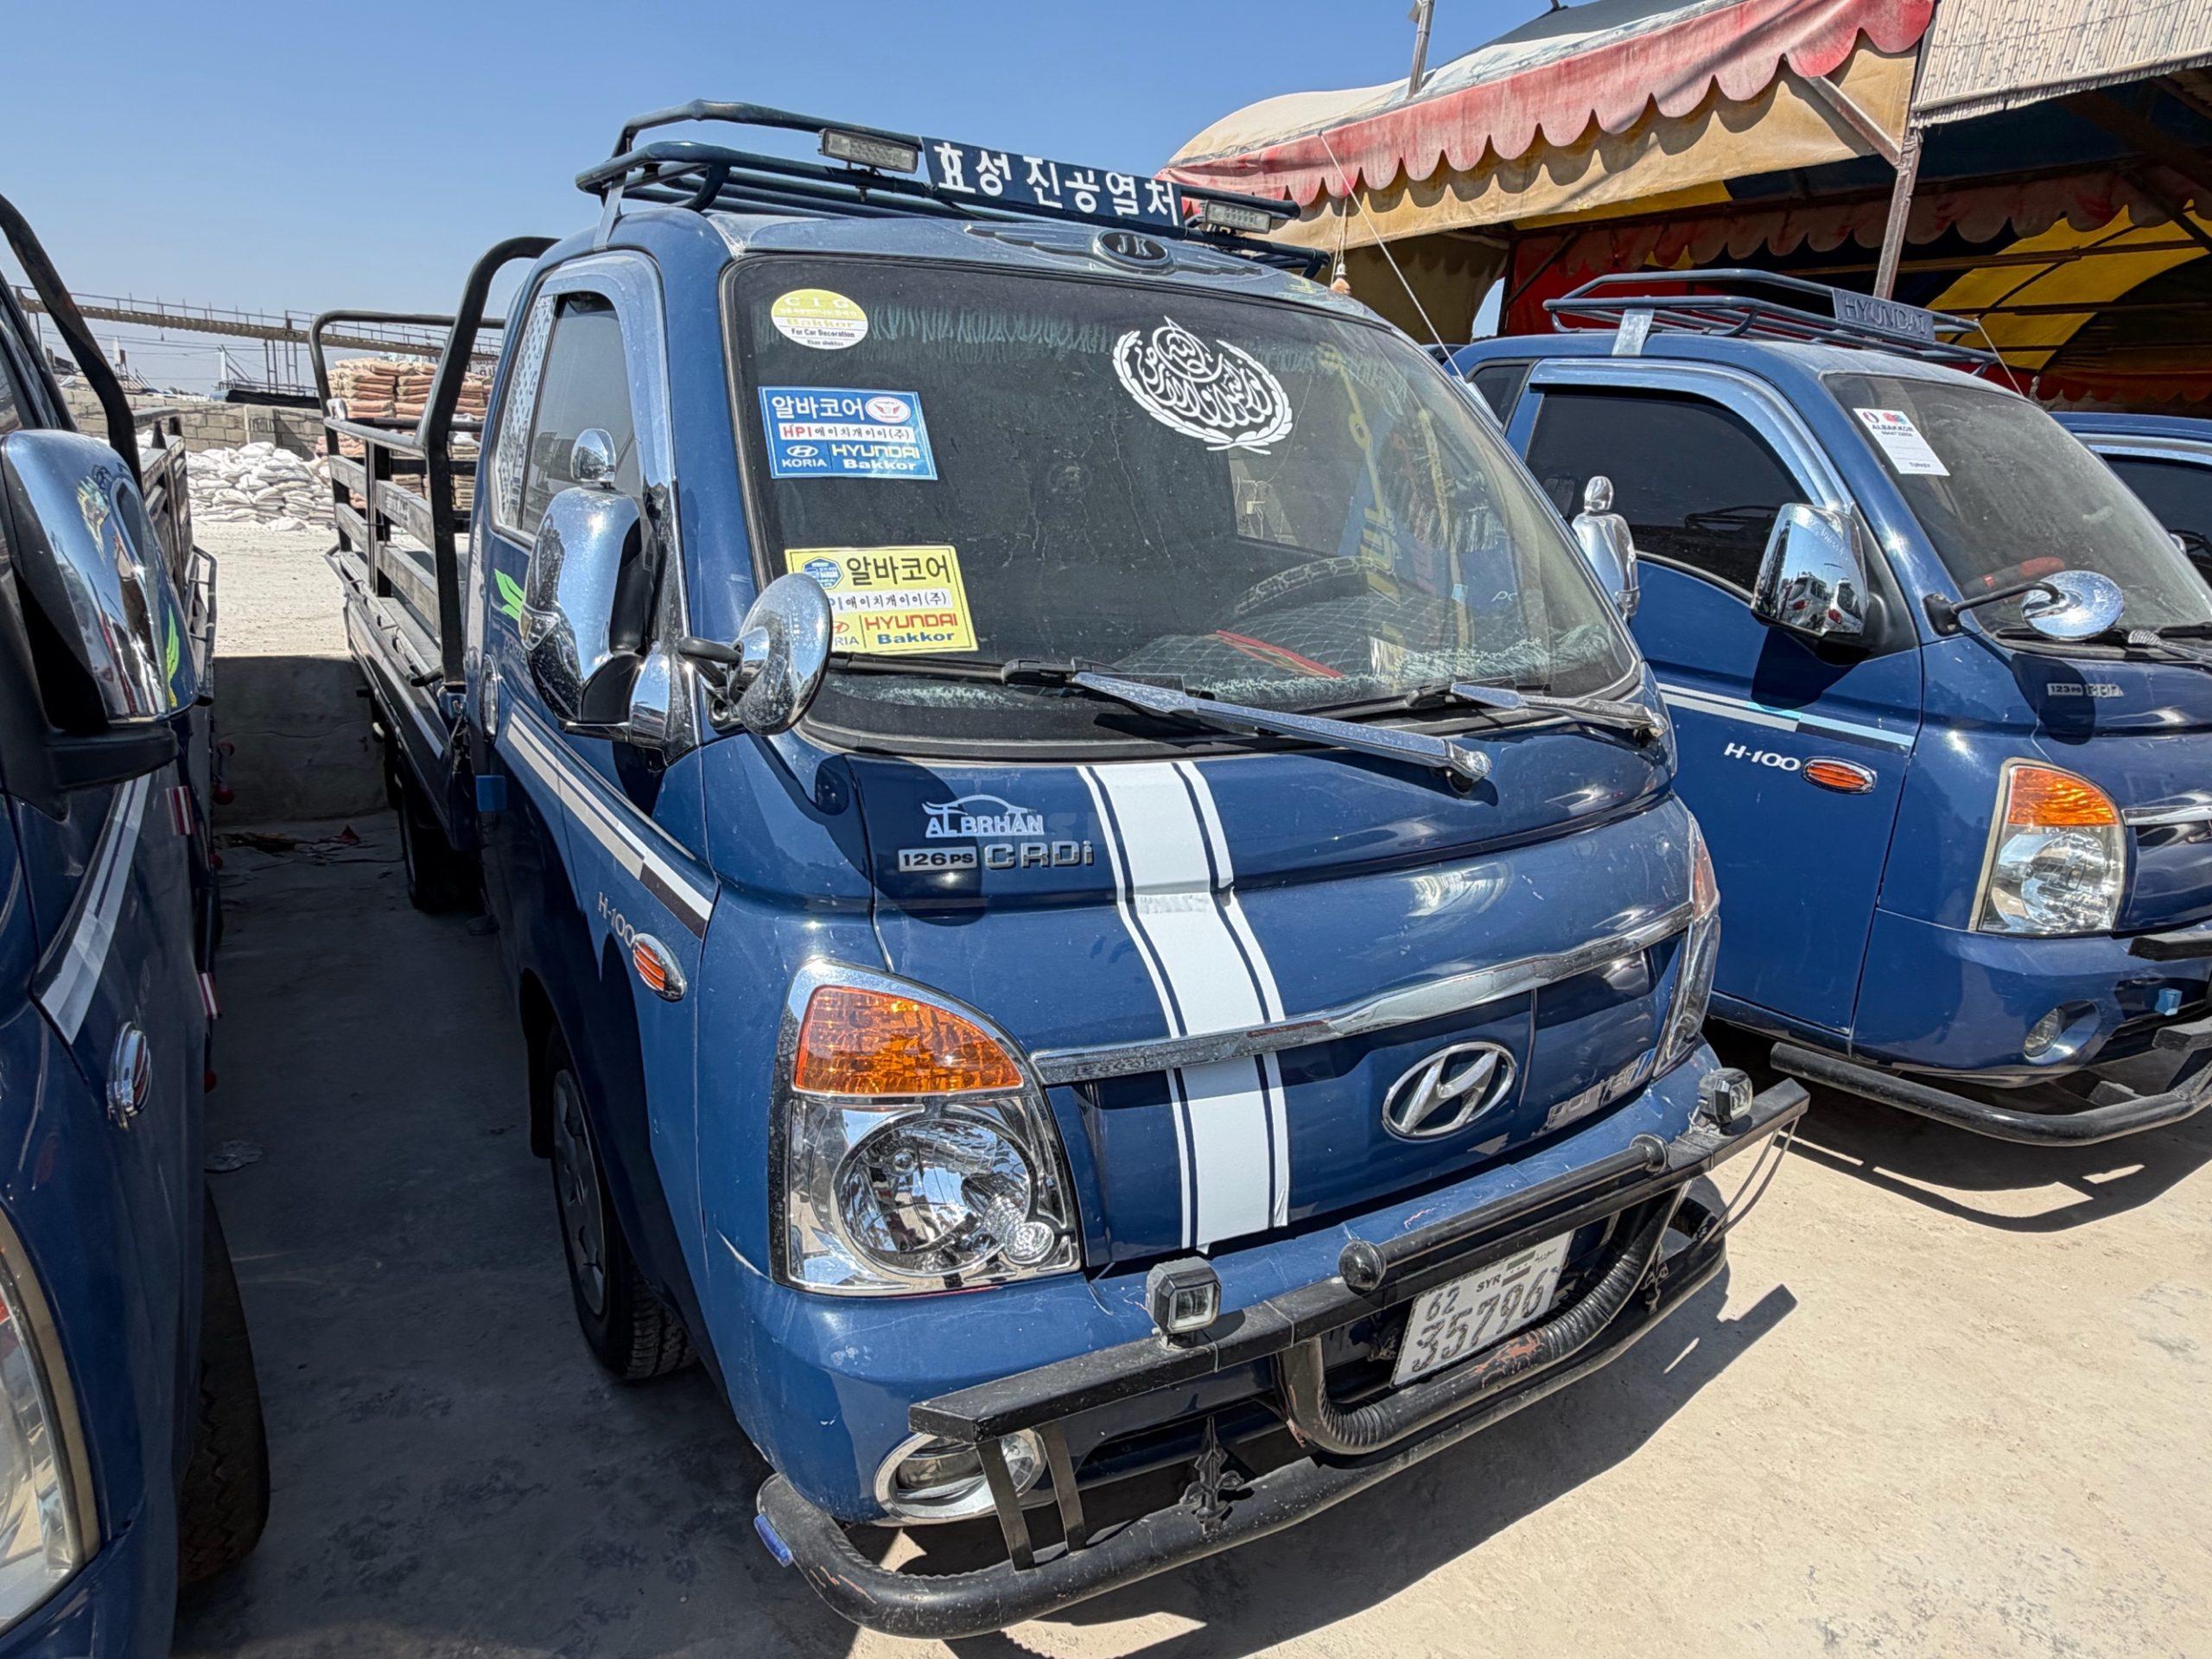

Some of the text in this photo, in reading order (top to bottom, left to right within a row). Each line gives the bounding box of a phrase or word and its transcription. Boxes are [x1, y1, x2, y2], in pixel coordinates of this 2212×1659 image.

[933, 142, 1012, 197] 효성
[1844, 297, 1927, 335] HYUNDAI
[818, 329, 855, 338] Decoration
[772, 395, 865, 421] 알바코어
[783, 425, 812, 438] HPI
[781, 458, 828, 468] KORIA
[831, 443, 920, 460] HYUNDAI
[842, 458, 918, 472] Bakkor
[846, 555, 951, 587] 알바코어
[864, 613, 958, 632] HYUNDAI
[877, 632, 956, 646] Bakkor
[1723, 741, 1802, 772] H-100
[983, 839, 1095, 871] CRDi
[597, 891, 635, 949] H-100
[1476, 1273, 1503, 1293] SYR
[1426, 1286, 1460, 1322] 62
[1411, 1268, 1549, 1373] 35796
